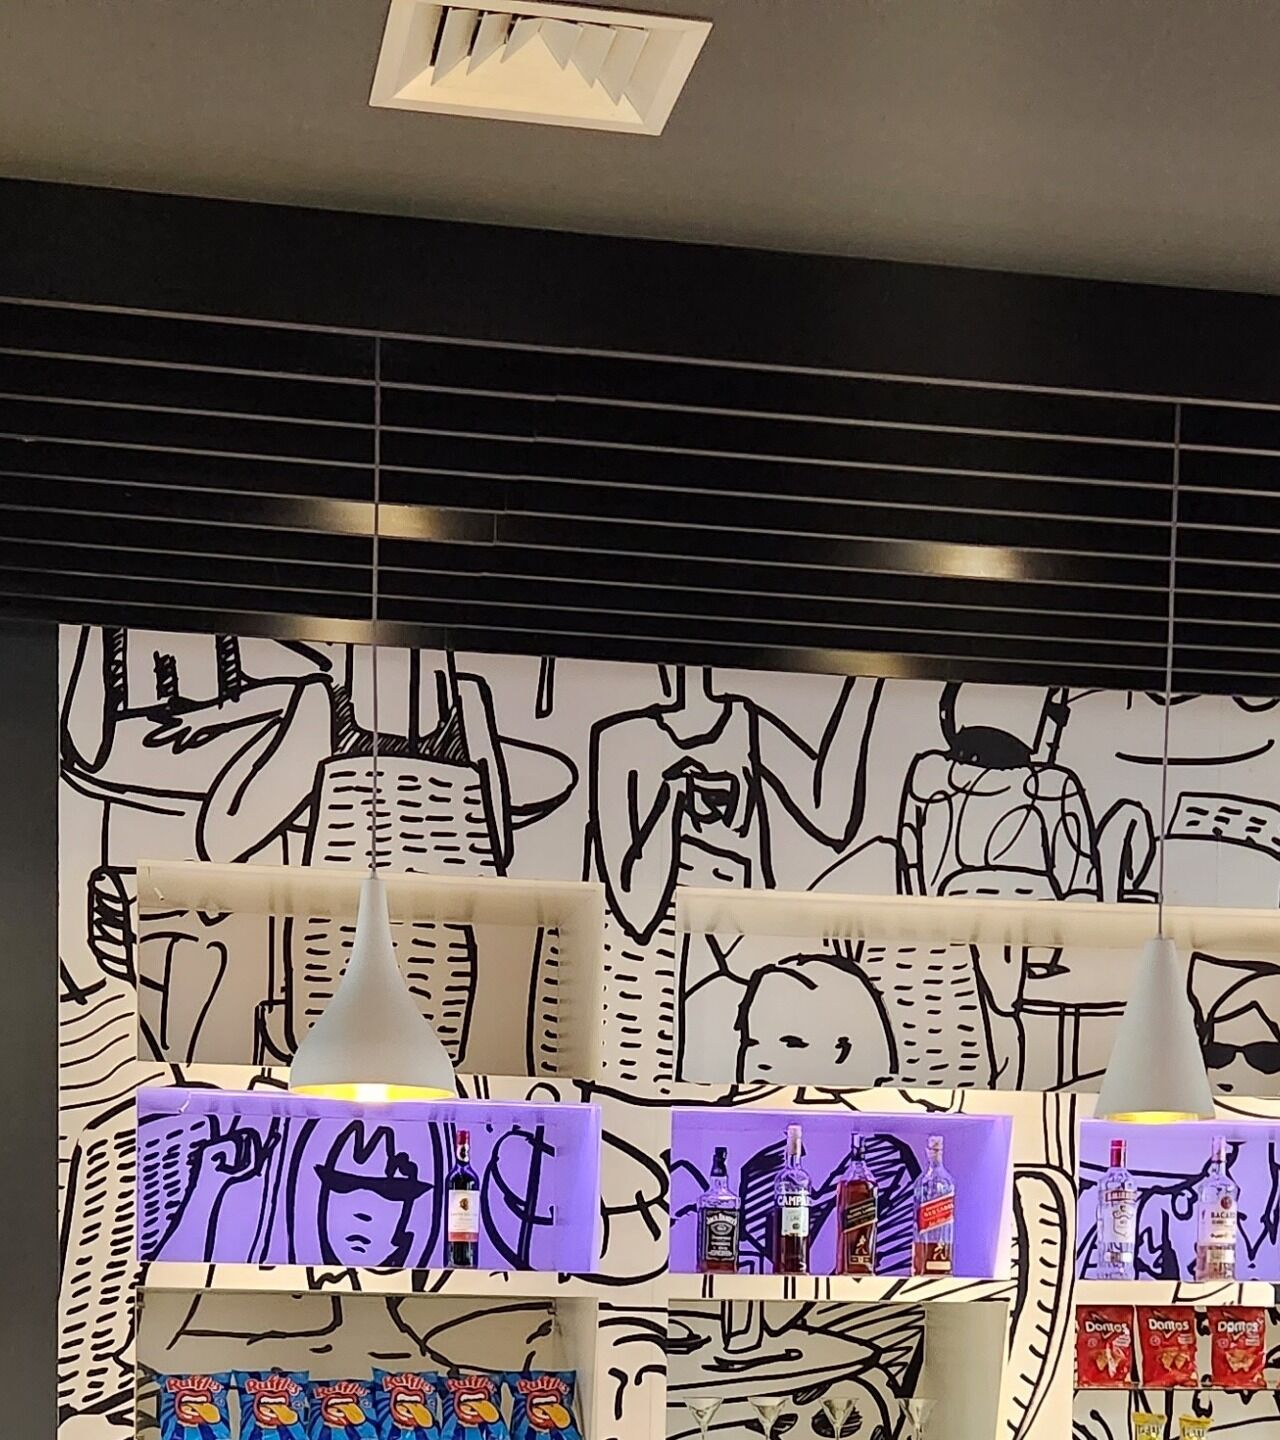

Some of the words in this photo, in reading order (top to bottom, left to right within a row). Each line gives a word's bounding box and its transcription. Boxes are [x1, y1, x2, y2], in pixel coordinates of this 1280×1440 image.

[1085, 1319, 1128, 1333] Doritos
[1148, 1318, 1189, 1331] Doritos
[1217, 1320, 1258, 1333] Doritos
[166, 1375, 224, 1394] Ruffles
[244, 1375, 303, 1396] Ruffles
[313, 1381, 370, 1399] Ruffles
[381, 1373, 436, 1394] Ruffles
[446, 1374, 498, 1394] Ruffles
[516, 1375, 571, 1395] Ruffles
